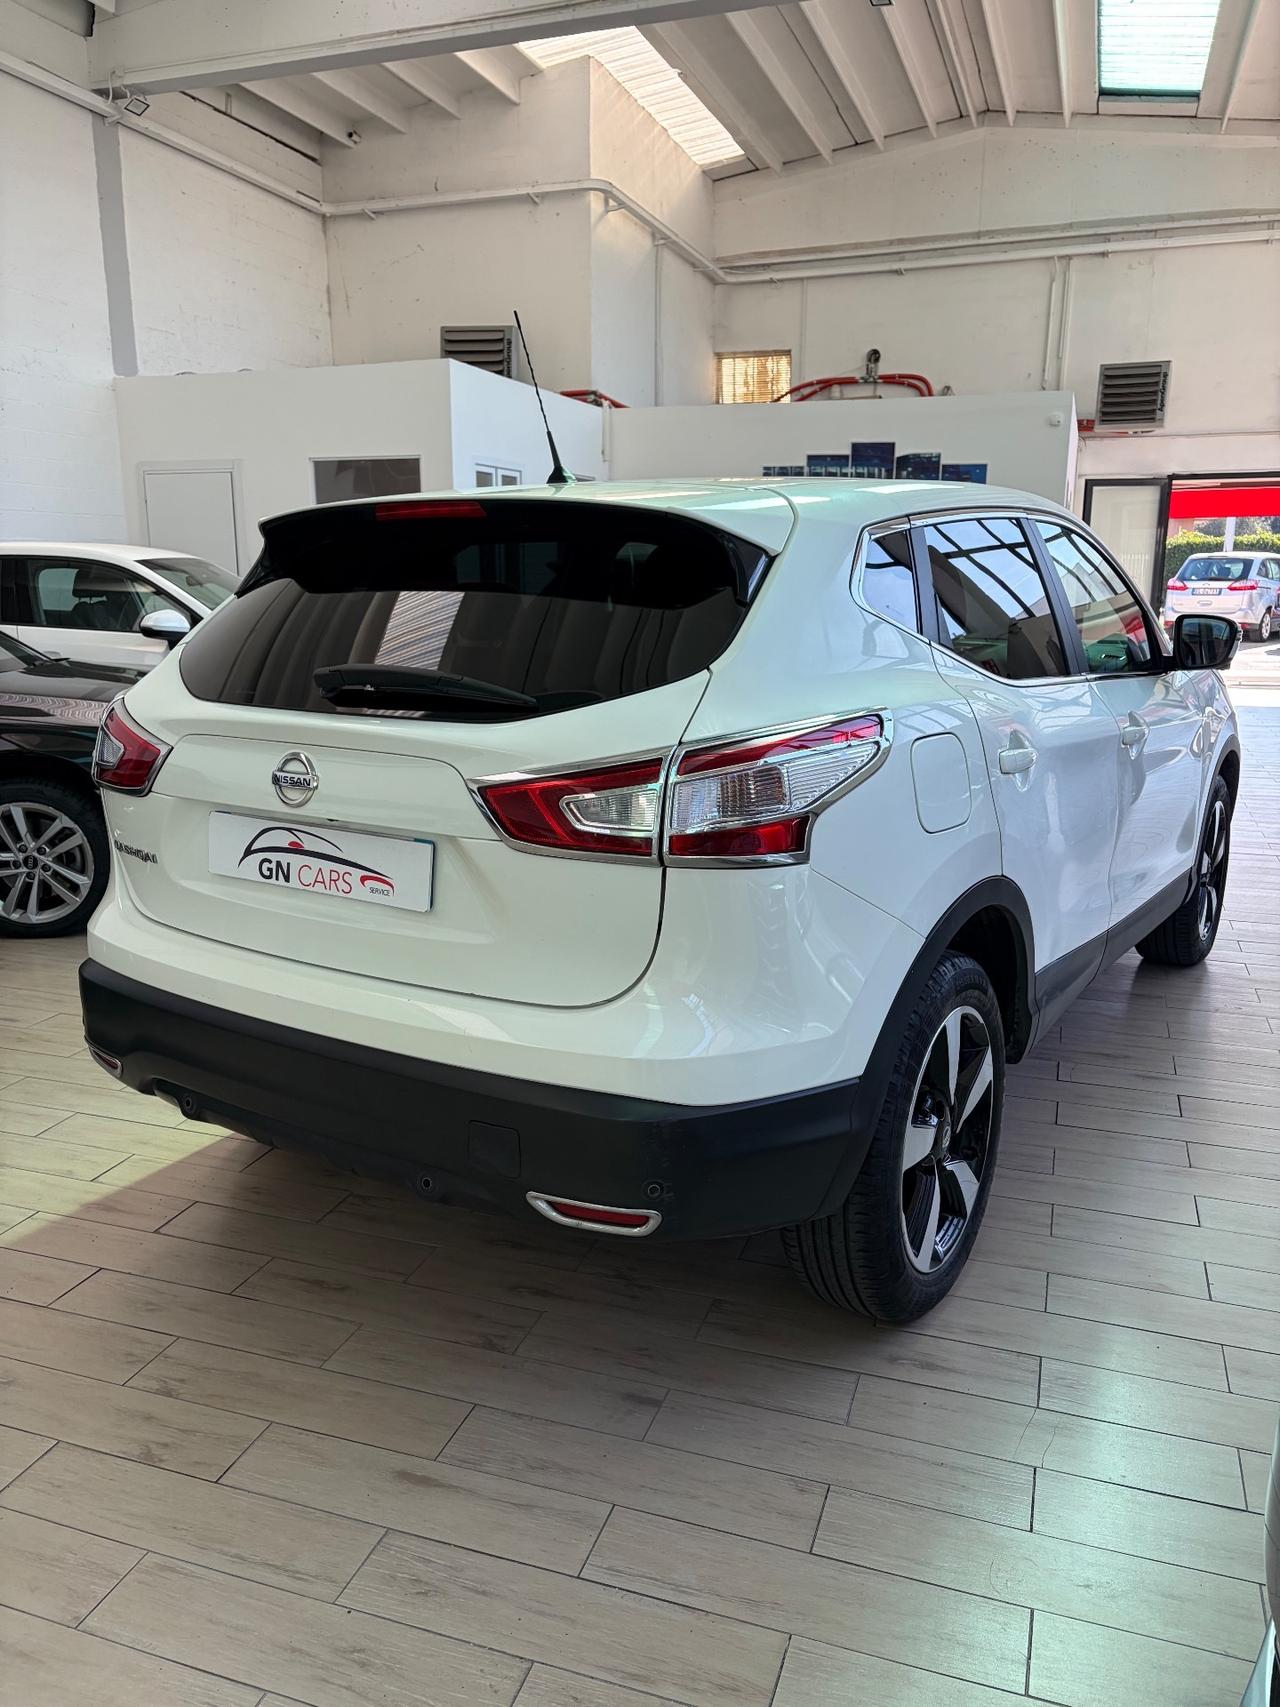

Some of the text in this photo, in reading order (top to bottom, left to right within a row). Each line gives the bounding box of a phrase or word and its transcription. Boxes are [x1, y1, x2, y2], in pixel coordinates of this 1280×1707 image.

[273, 773, 311, 787] NISSAN
[258, 857, 353, 895] GN CARS
[369, 886, 391, 897] SERVICE
